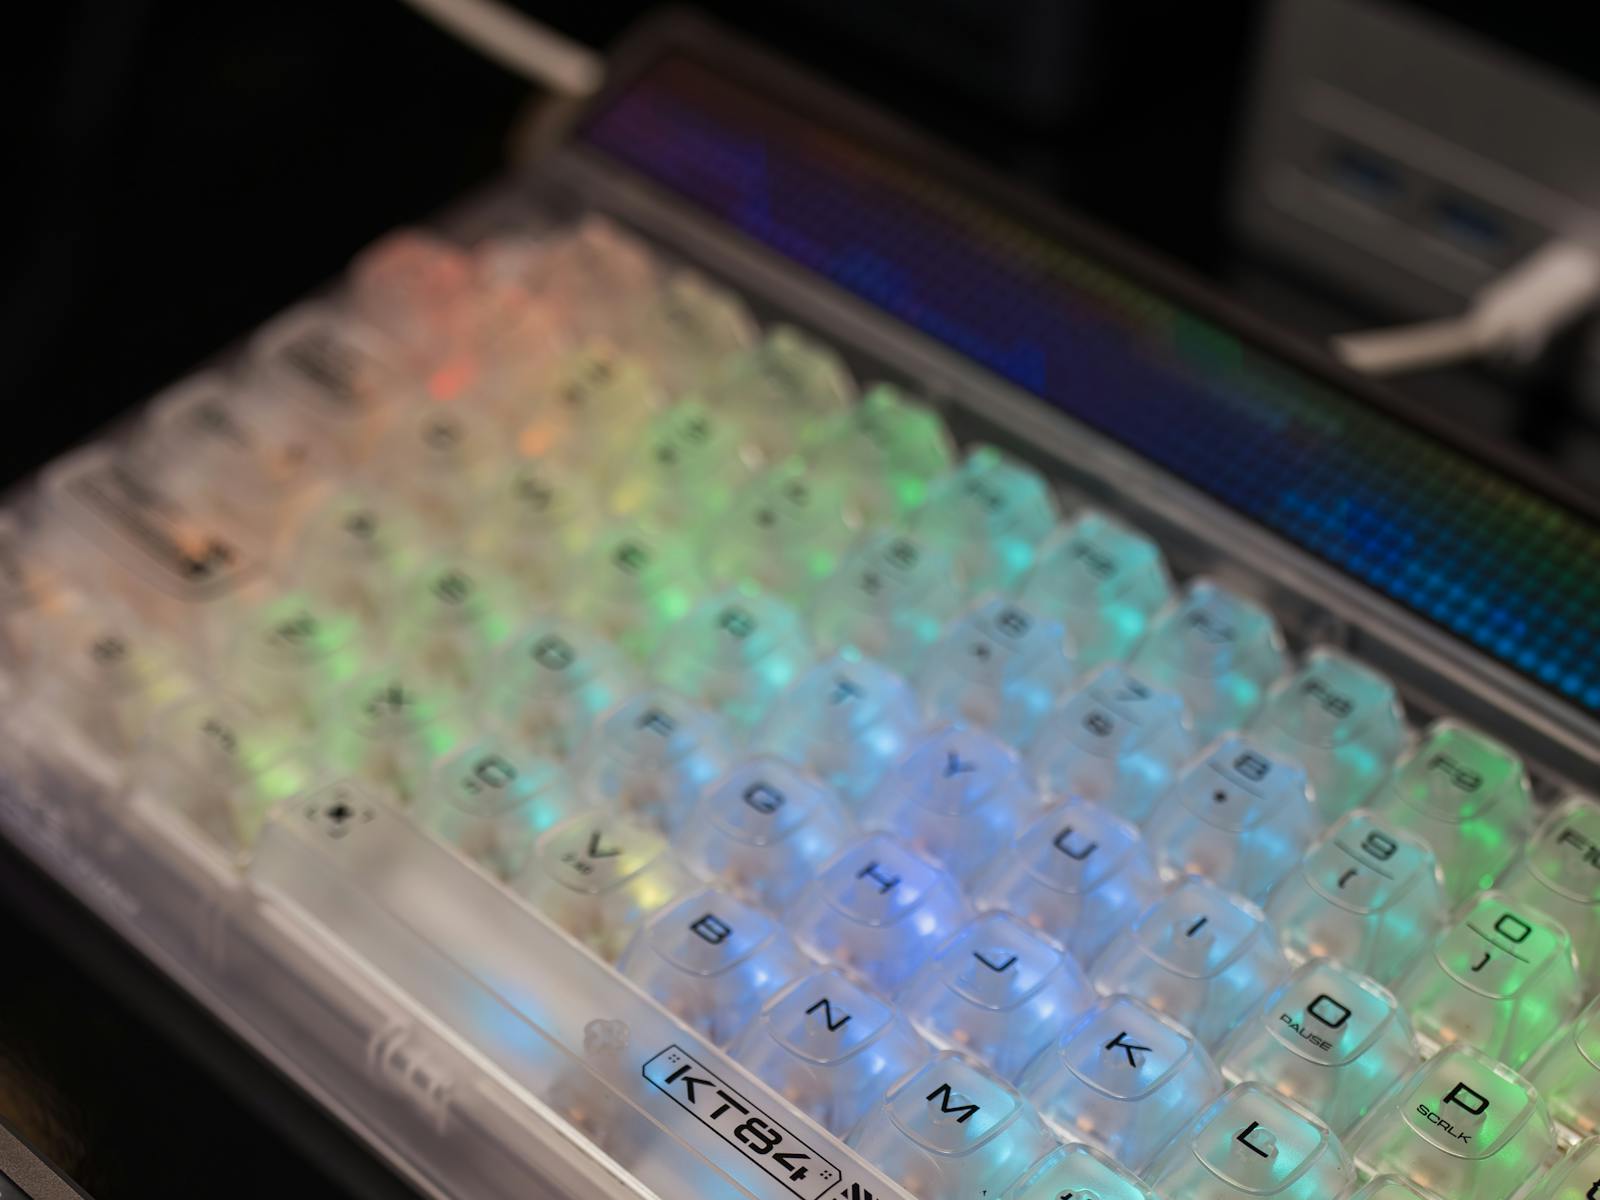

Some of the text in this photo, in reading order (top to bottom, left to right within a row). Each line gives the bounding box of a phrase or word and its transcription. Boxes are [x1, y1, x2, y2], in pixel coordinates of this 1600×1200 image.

[944, 750, 979, 779] Y
[1053, 826, 1099, 860] U
[857, 860, 904, 895] H
[689, 914, 734, 946] B
[1185, 916, 1208, 938] I
[973, 951, 1019, 972] J
[805, 998, 851, 1032] N
[1279, 1013, 1334, 1052] PAUSE
[1104, 1031, 1153, 1069] K
[926, 1083, 980, 1123] M
[1443, 1082, 1490, 1116] P
[664, 1064, 811, 1182] KT84
[1235, 1120, 1270, 1159] L
[1416, 1103, 1473, 1145] SCRLK
